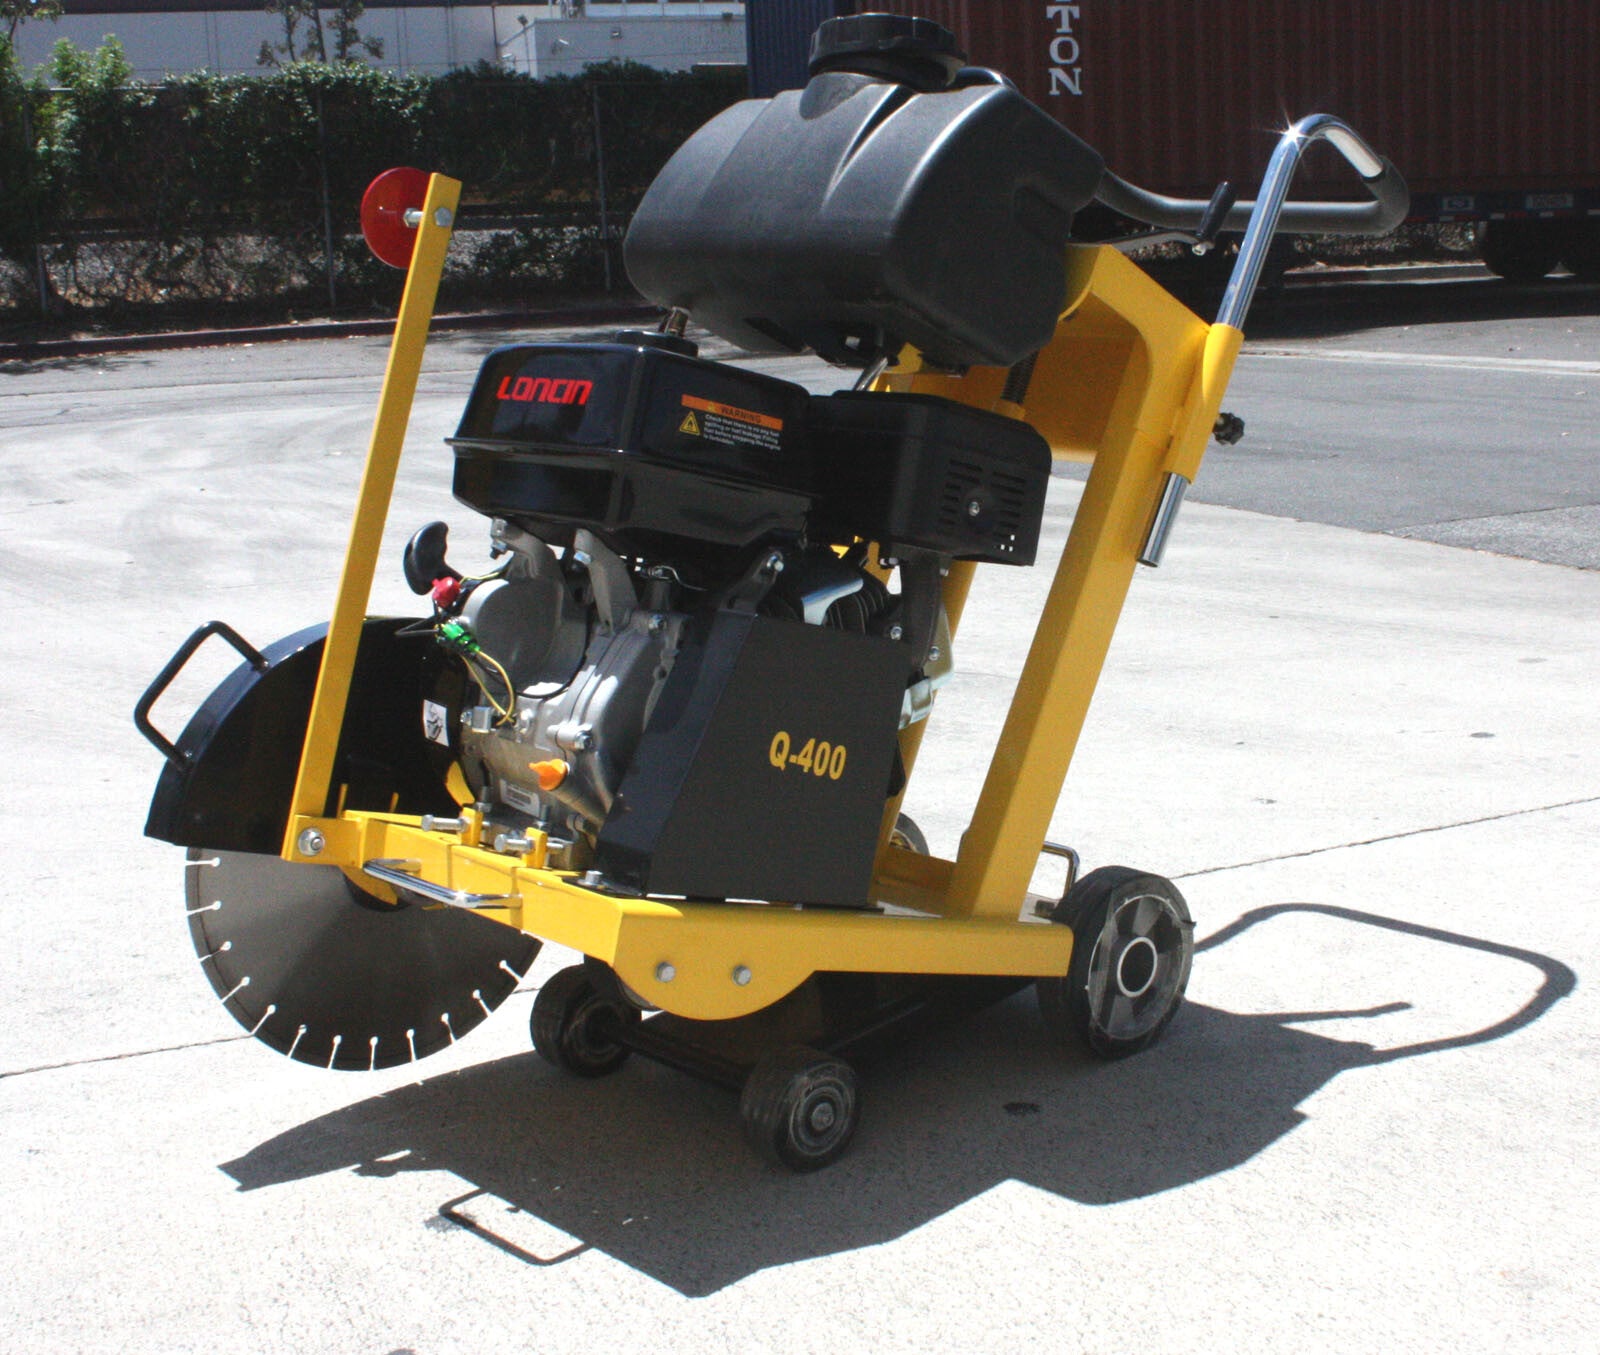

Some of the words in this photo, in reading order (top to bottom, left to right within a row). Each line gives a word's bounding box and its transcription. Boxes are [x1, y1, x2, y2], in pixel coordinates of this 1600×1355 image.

[1046, 0, 1083, 96] TON
[720, 407, 761, 423] WARNING
[769, 731, 847, 780] Q-400
